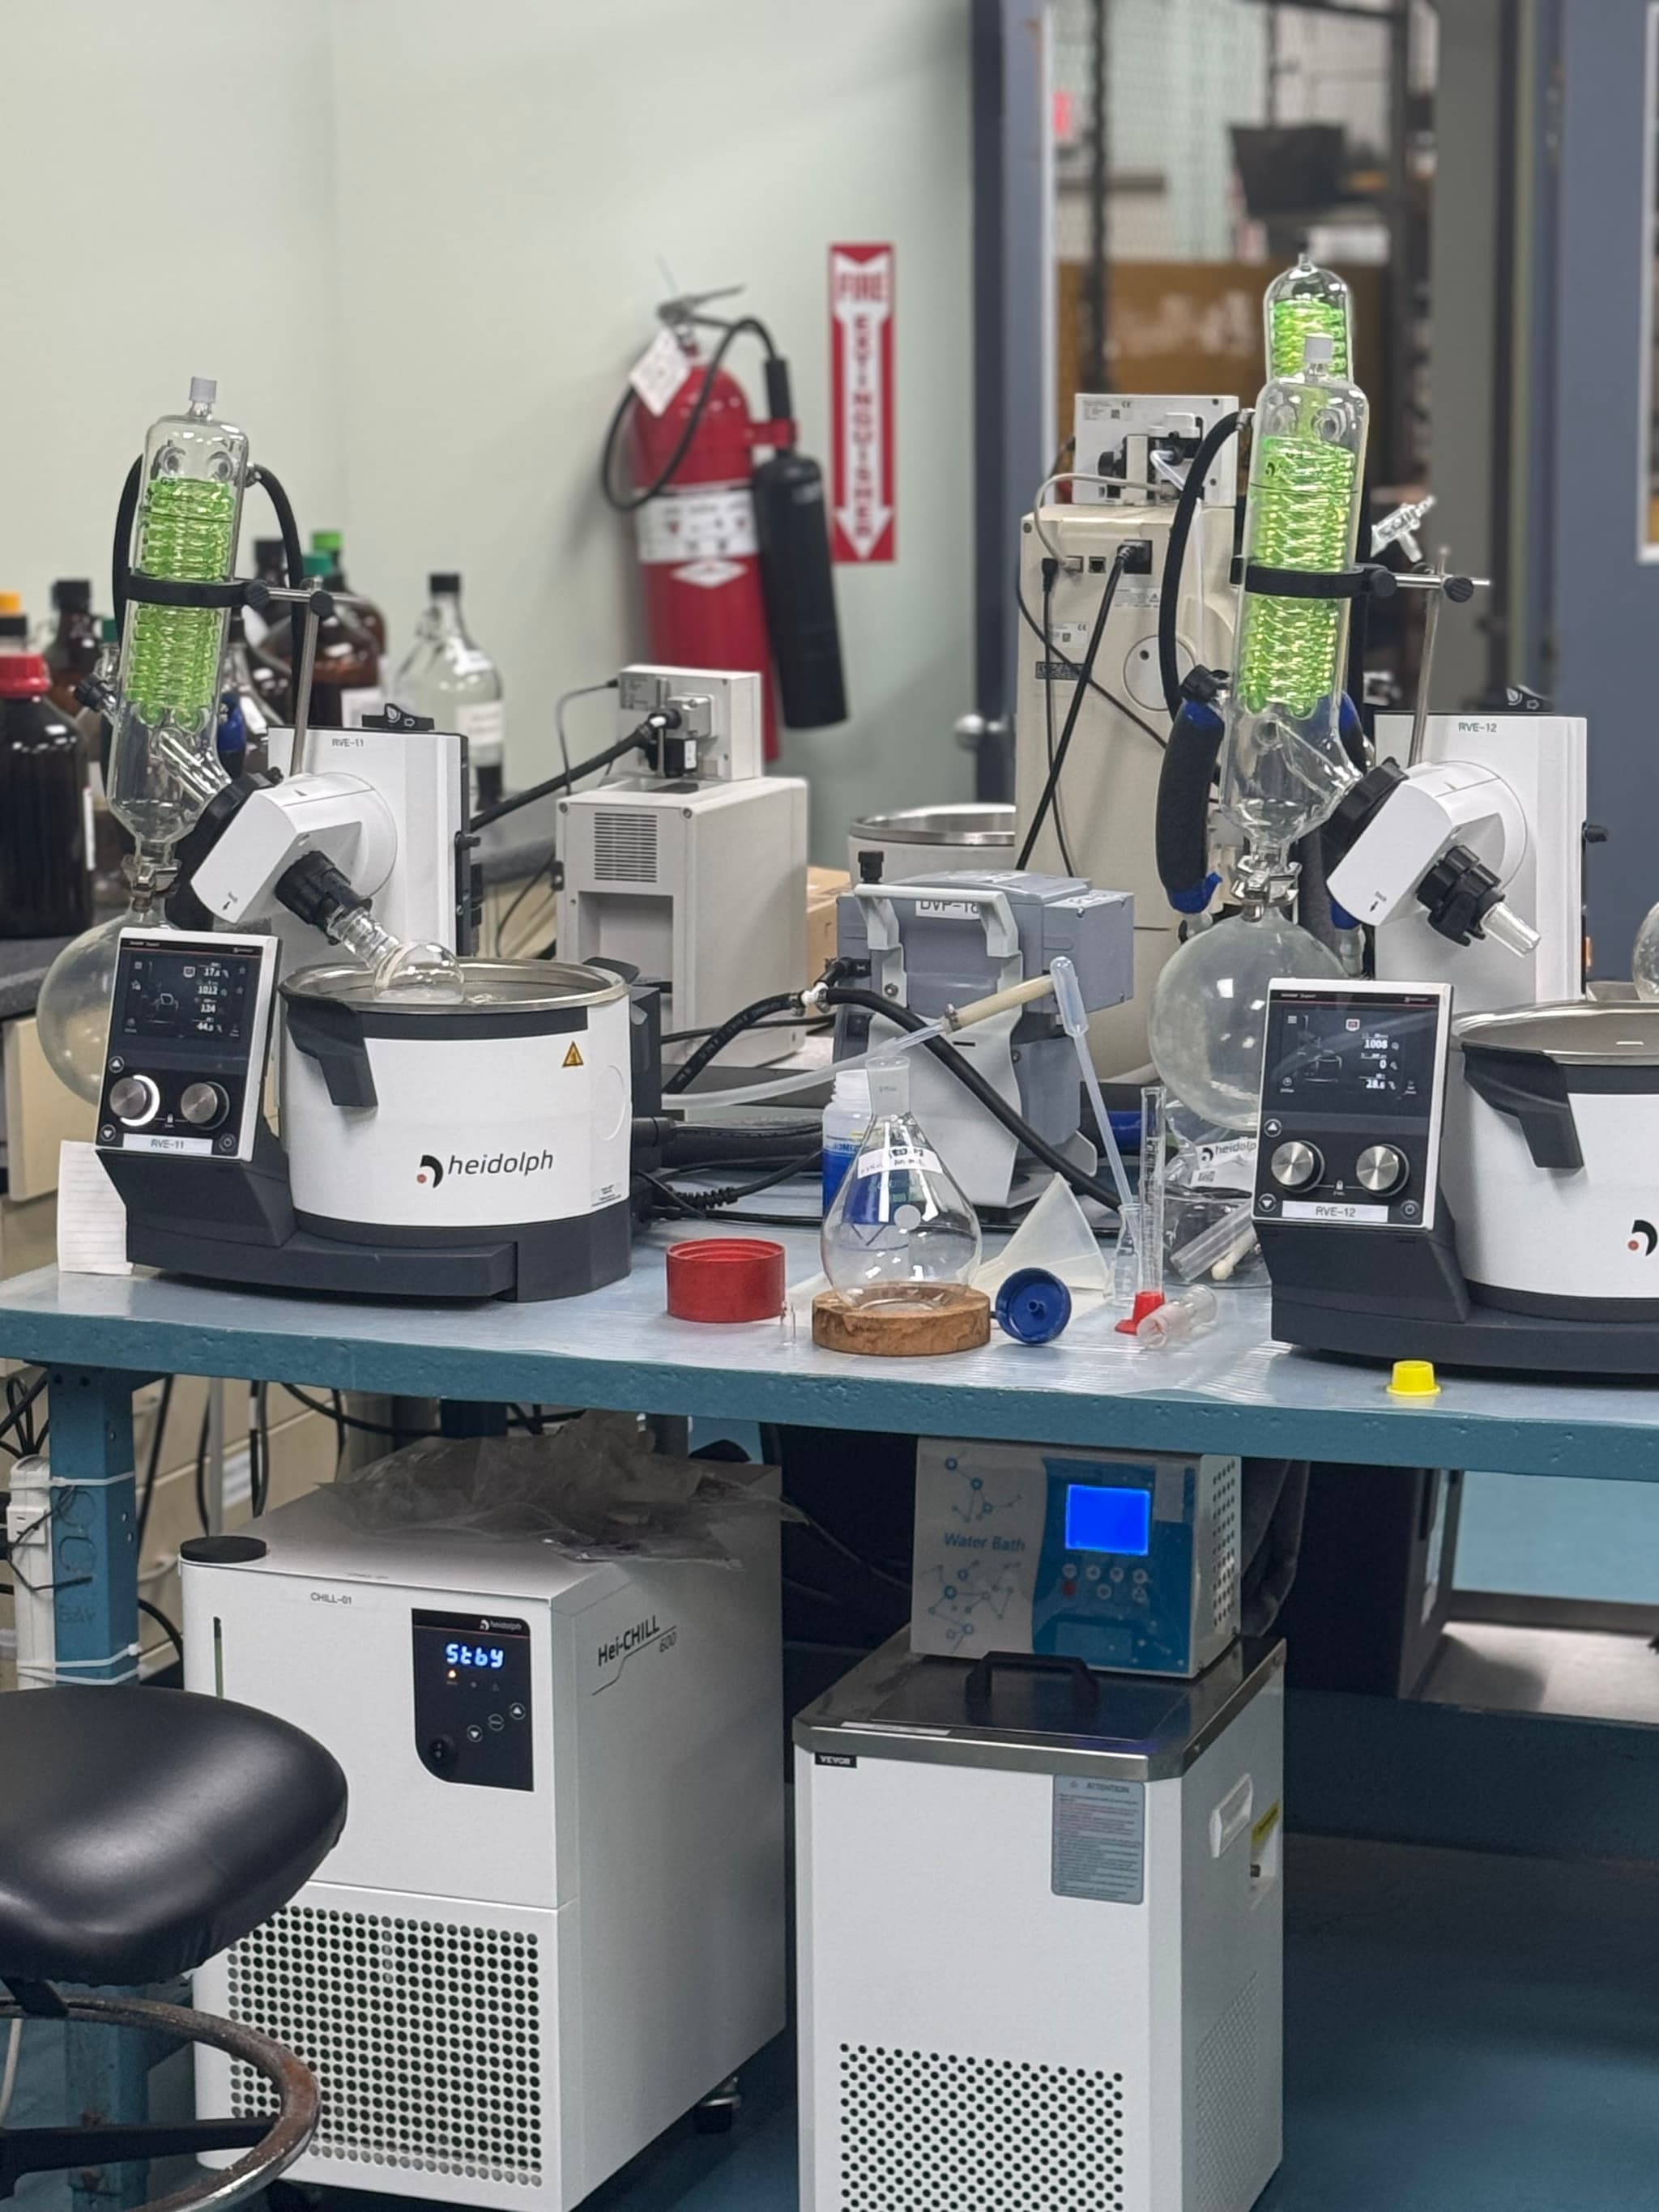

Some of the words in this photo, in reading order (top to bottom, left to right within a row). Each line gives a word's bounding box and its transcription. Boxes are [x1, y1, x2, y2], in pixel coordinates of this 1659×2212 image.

[838, 272, 885, 302] FIRE
[853, 316, 873, 537] EXTINGUISHER
[1458, 722, 1497, 732] RVE-12
[332, 738, 364, 747] RVE-11
[151, 1139, 184, 1149] RVE-11
[1215, 1140, 1257, 1154] heidolp
[447, 1149, 553, 1176] heidolph
[1316, 1206, 1356, 1217] RVE-12
[945, 1531, 987, 1548] Water
[992, 1535, 1026, 1552] Bath
[310, 1592, 352, 1605] CHILL-01
[598, 1614, 660, 1667] Hei-CHILL
[820, 1755, 851, 1766] VEVOR
